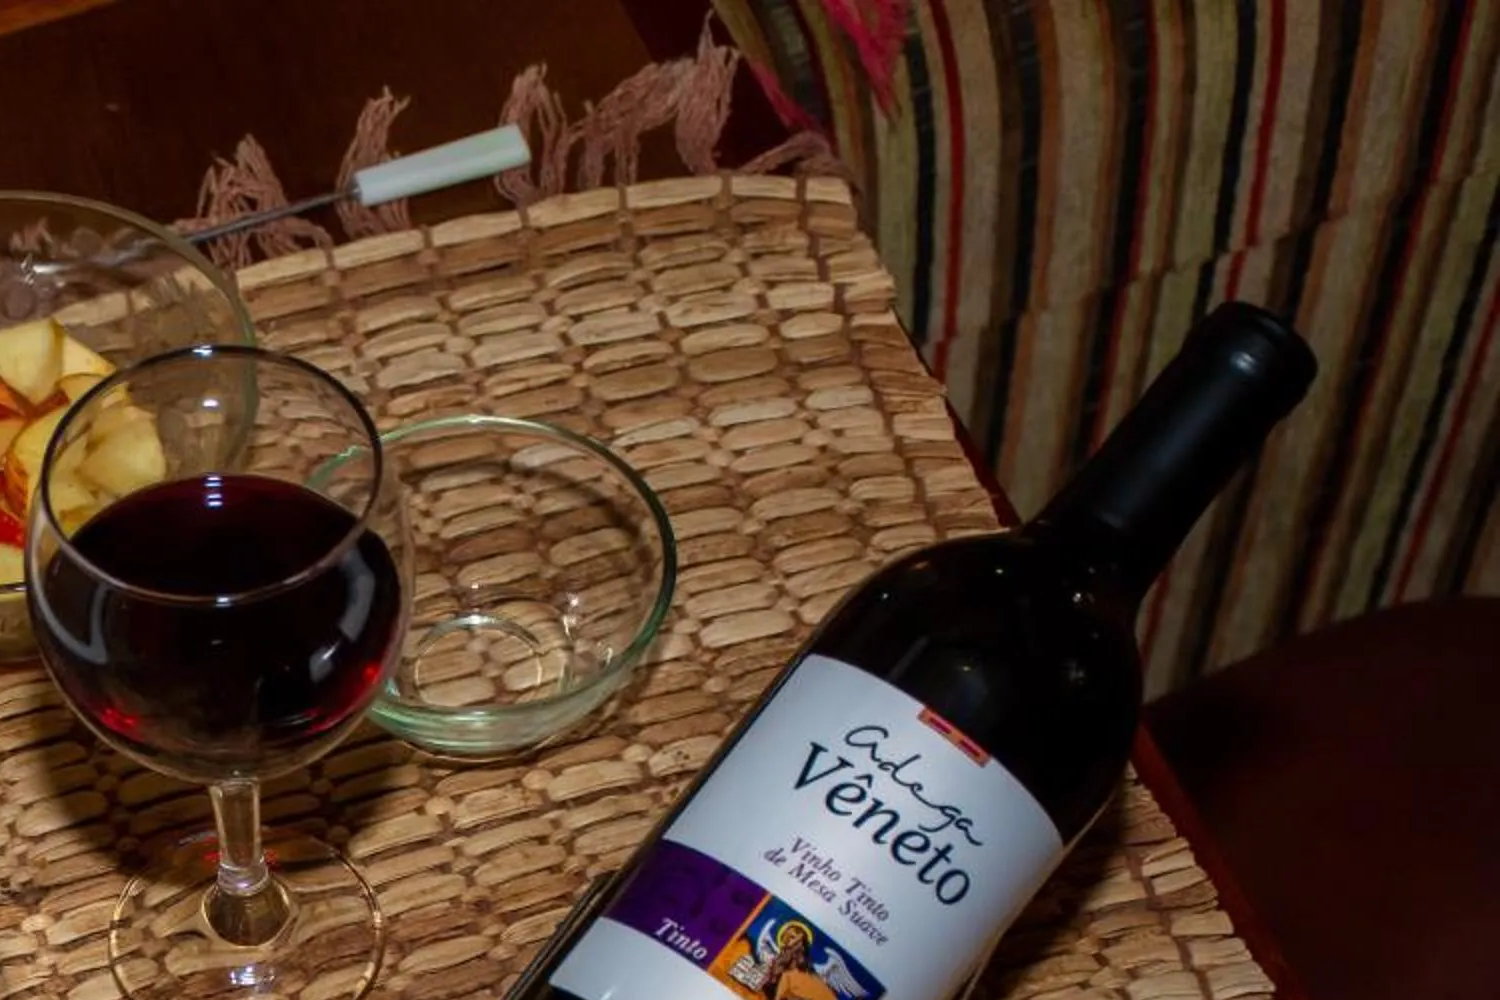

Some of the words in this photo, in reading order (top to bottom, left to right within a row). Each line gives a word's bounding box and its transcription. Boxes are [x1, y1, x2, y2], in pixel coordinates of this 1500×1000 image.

[794, 741, 971, 906] Vêneto
[763, 847, 788, 869] de
[788, 862, 837, 904] Mesa
[837, 900, 890, 947] Suave
[790, 837, 842, 882] Vinho
[843, 876, 890, 922] Tinto
[652, 917, 709, 961] Tinto
